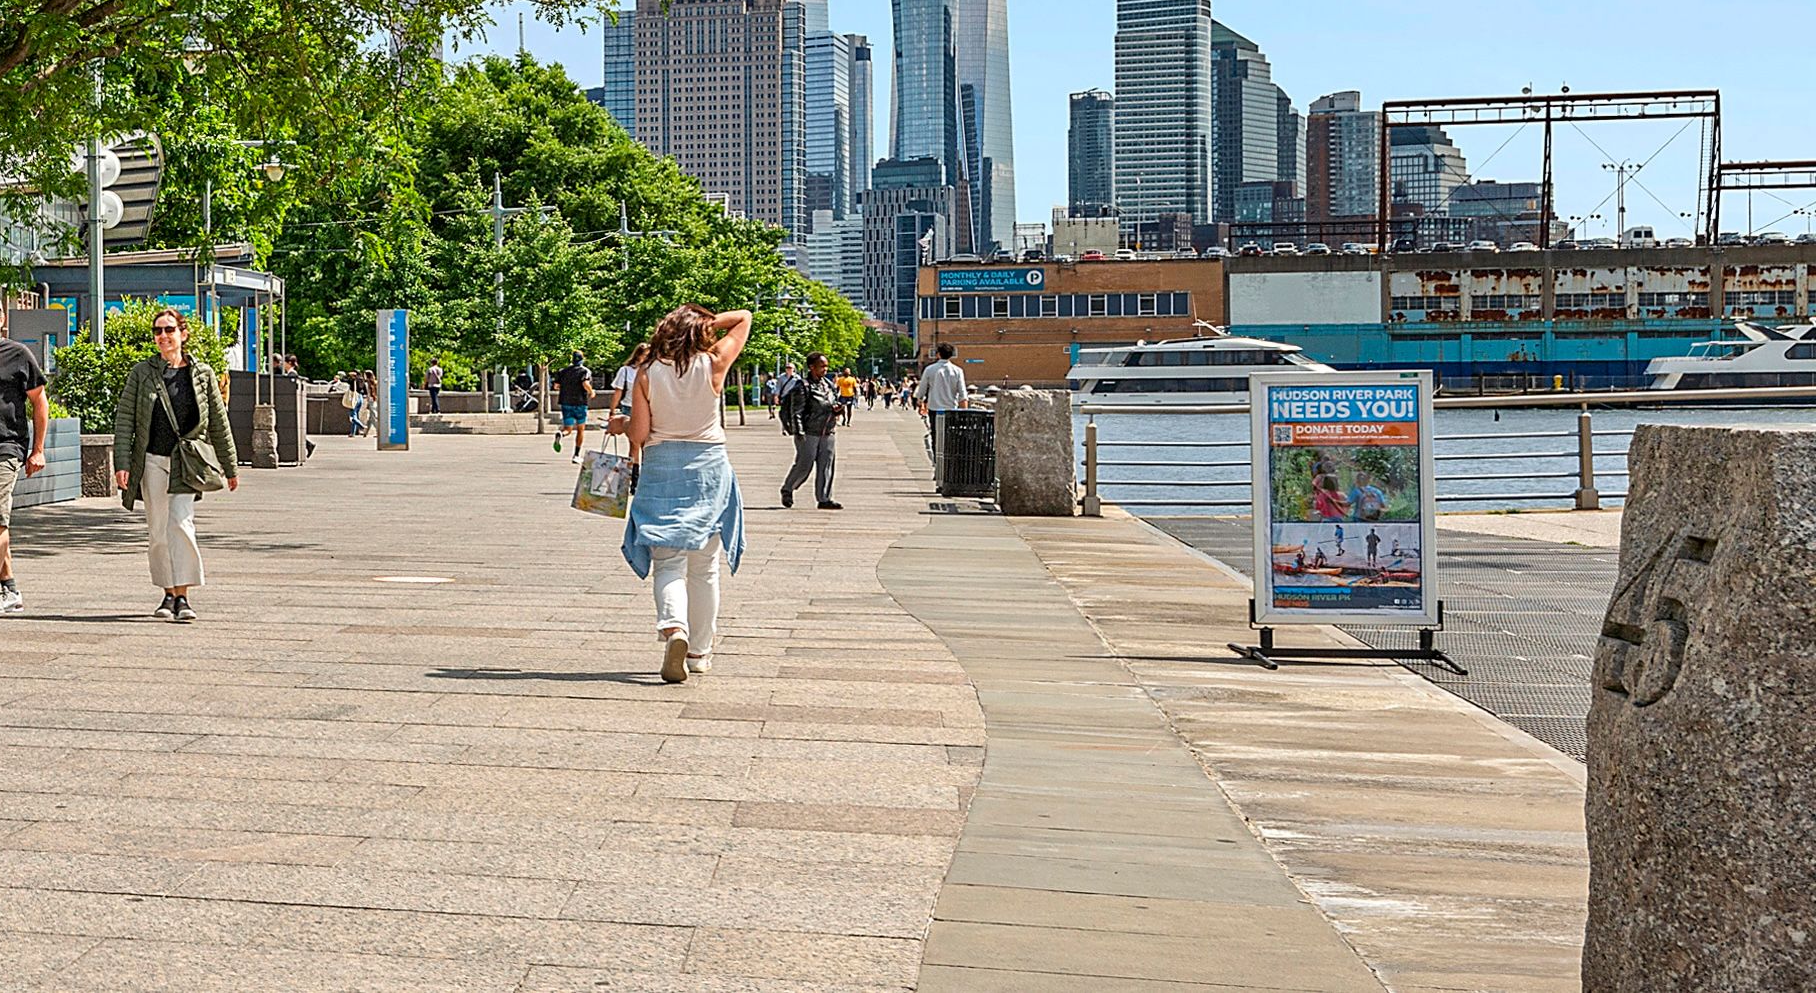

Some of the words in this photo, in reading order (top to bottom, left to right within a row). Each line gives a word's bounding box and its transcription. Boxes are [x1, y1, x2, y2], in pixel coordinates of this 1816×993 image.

[1272, 390, 1330, 401] HUDSON
[1333, 390, 1373, 400] RIVER
[1376, 389, 1414, 400] PARK
[1273, 401, 1352, 419] NEEDS
[1356, 400, 1415, 418] YOU!
[1296, 425, 1344, 434] DONATE
[1345, 424, 1385, 434] TODAY
